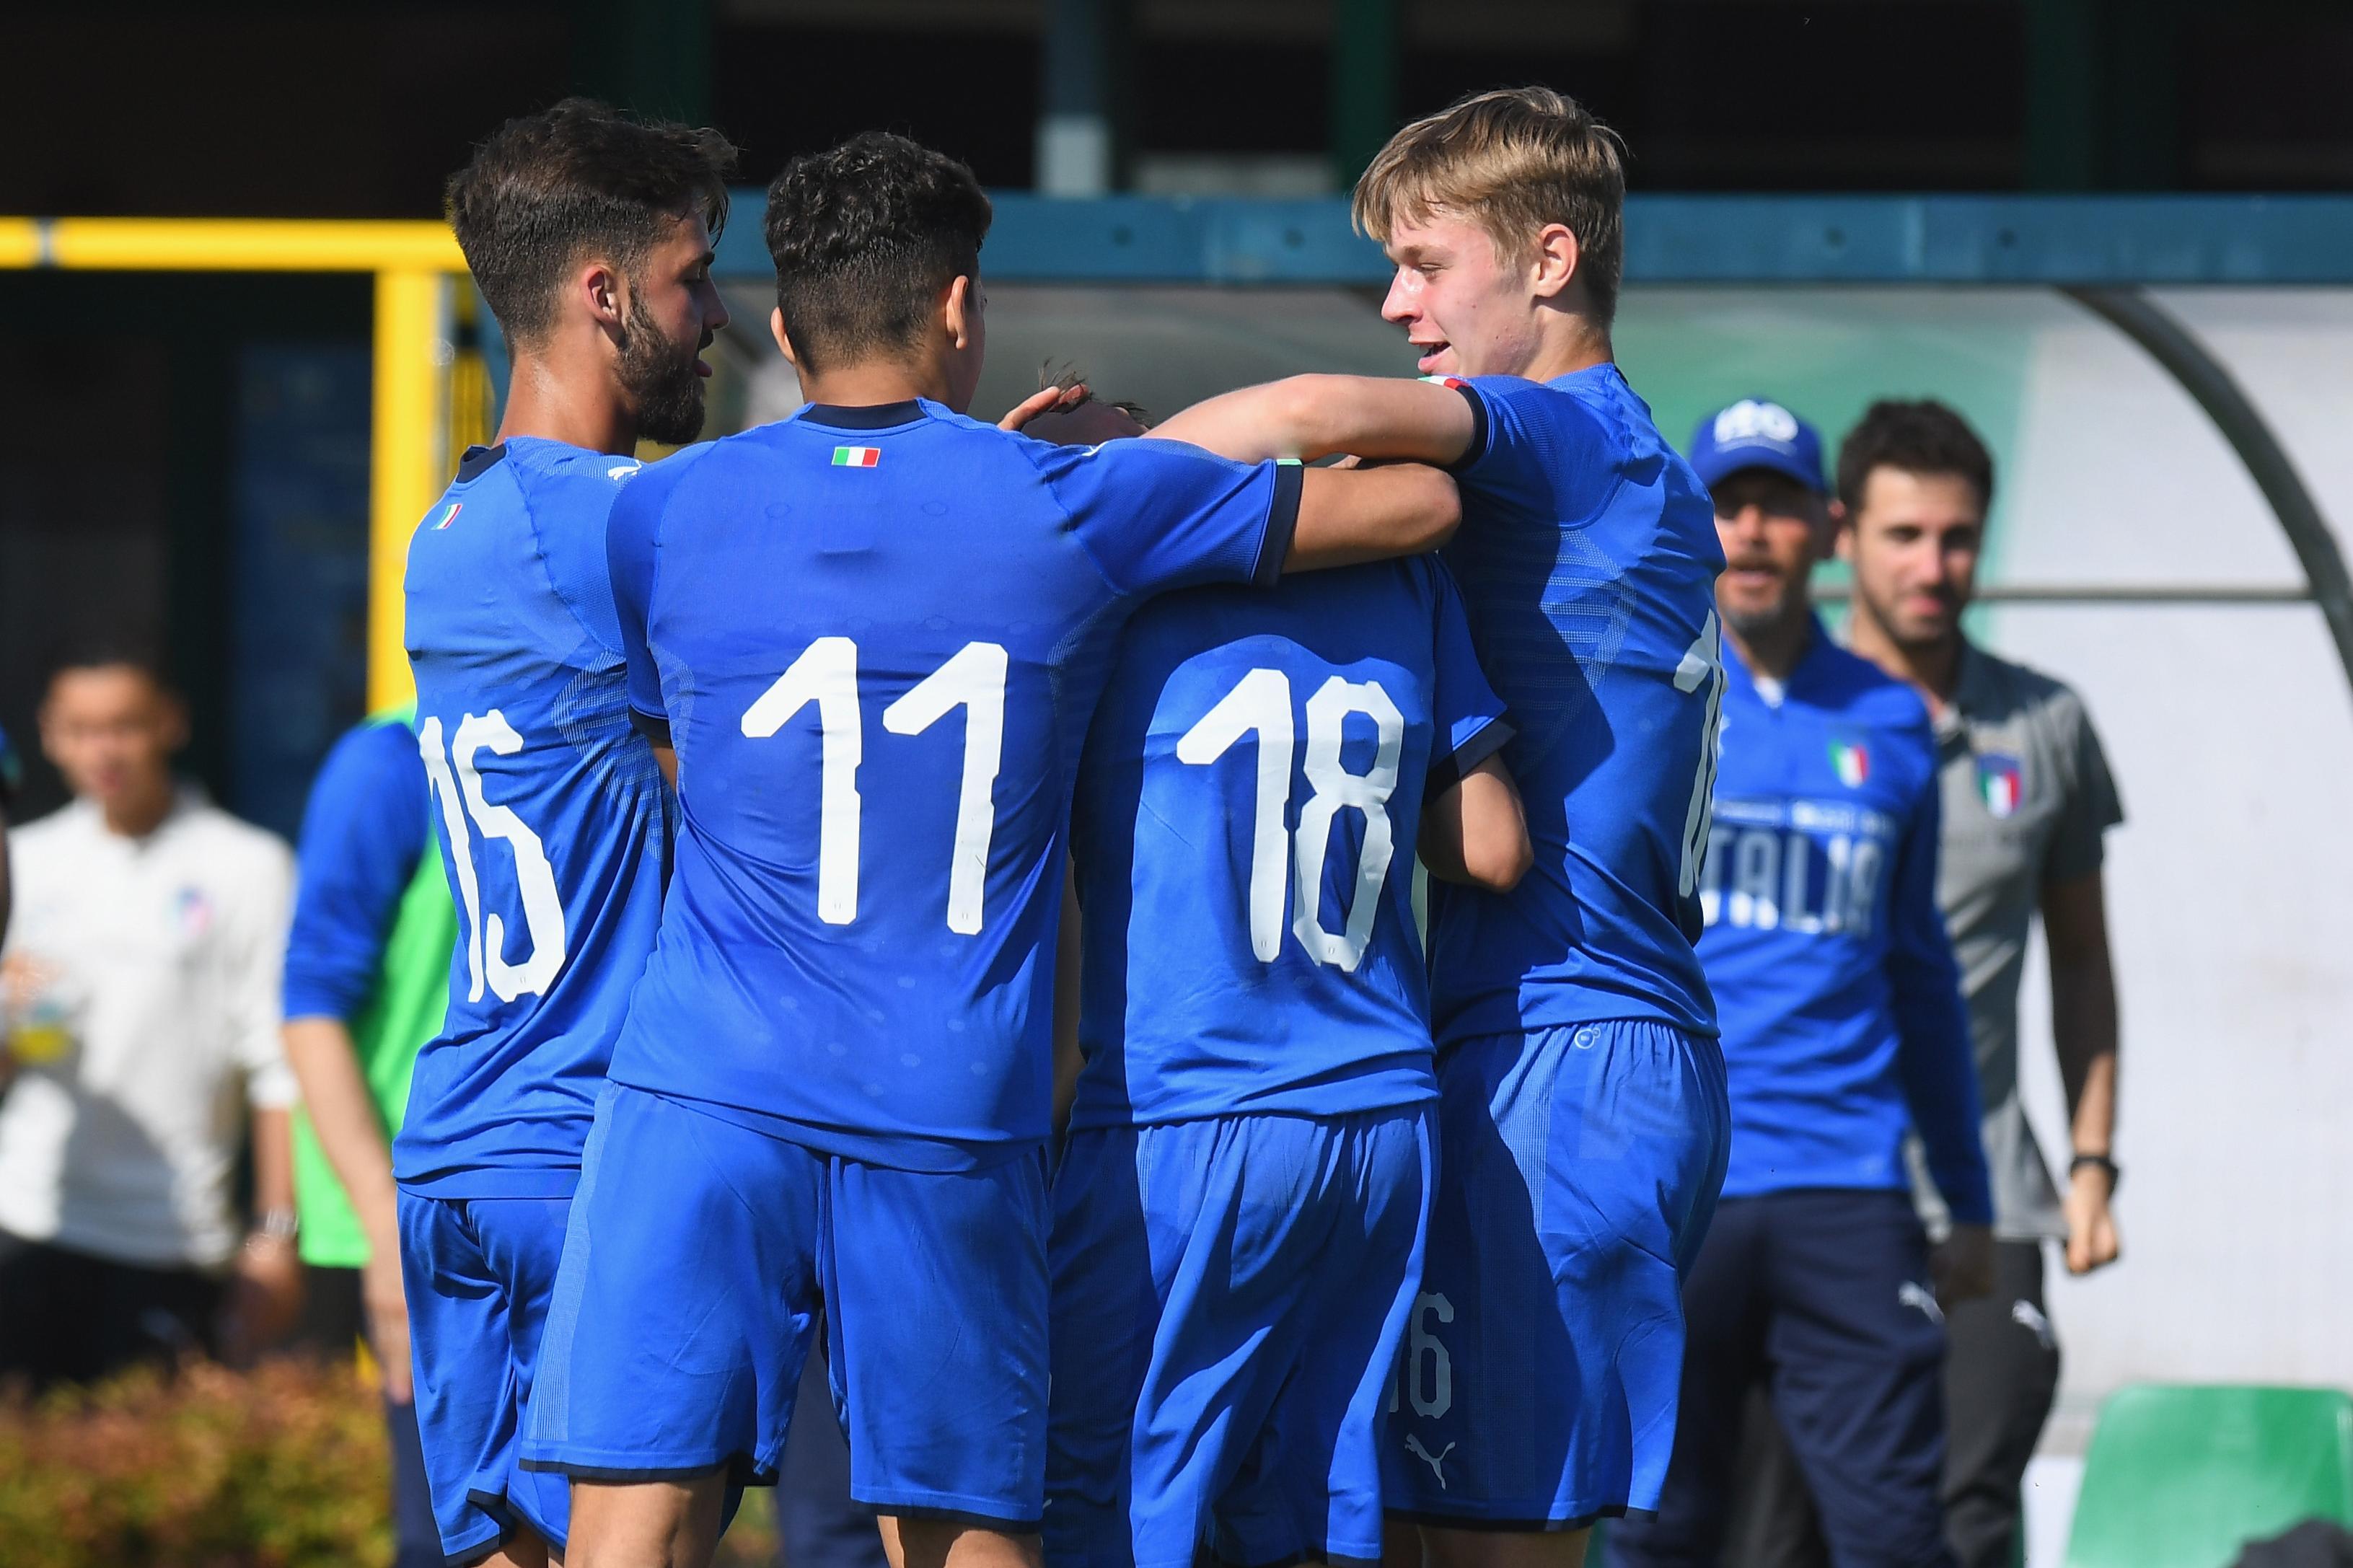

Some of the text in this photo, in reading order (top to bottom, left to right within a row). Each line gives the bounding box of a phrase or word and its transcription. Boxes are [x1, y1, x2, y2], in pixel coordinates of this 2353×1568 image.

[421, 710, 567, 1003] 15
[742, 638, 1008, 935] 11
[1177, 669, 1404, 972] 18
[1700, 829, 1884, 935] TALIA
[1390, 1292, 1454, 1419] 6
